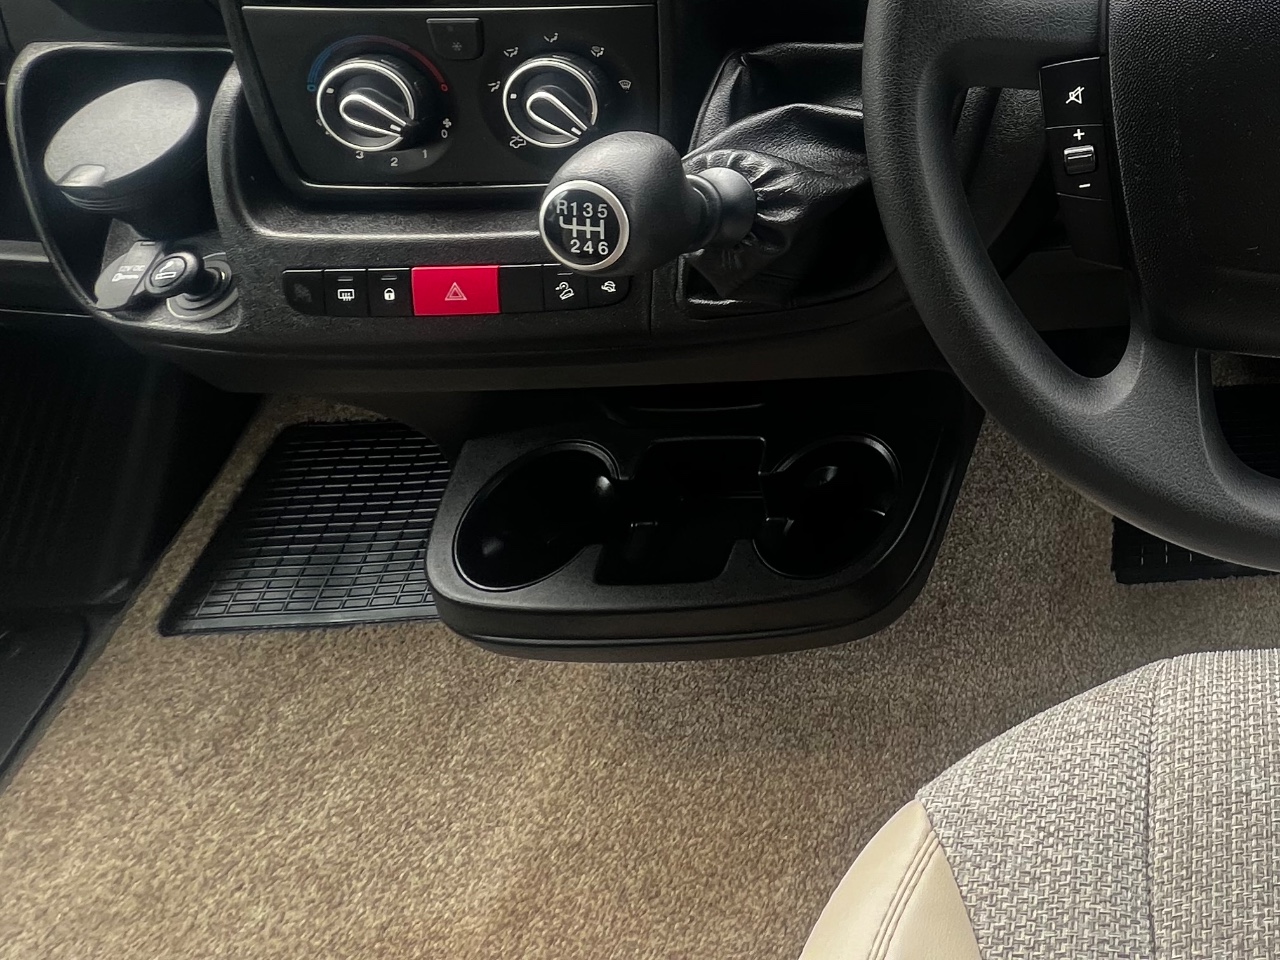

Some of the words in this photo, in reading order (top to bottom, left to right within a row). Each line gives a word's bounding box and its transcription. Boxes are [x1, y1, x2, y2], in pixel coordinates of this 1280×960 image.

[356, 150, 364, 159] 3
[422, 149, 428, 159] 1
[390, 157, 398, 166] 2
[556, 199, 568, 215] R
[570, 201, 577, 216] 1
[582, 202, 593, 217] 3
[597, 203, 608, 218] 5
[570, 239, 581, 253] 2
[582, 240, 594, 255] 4
[598, 241, 609, 255] 6
